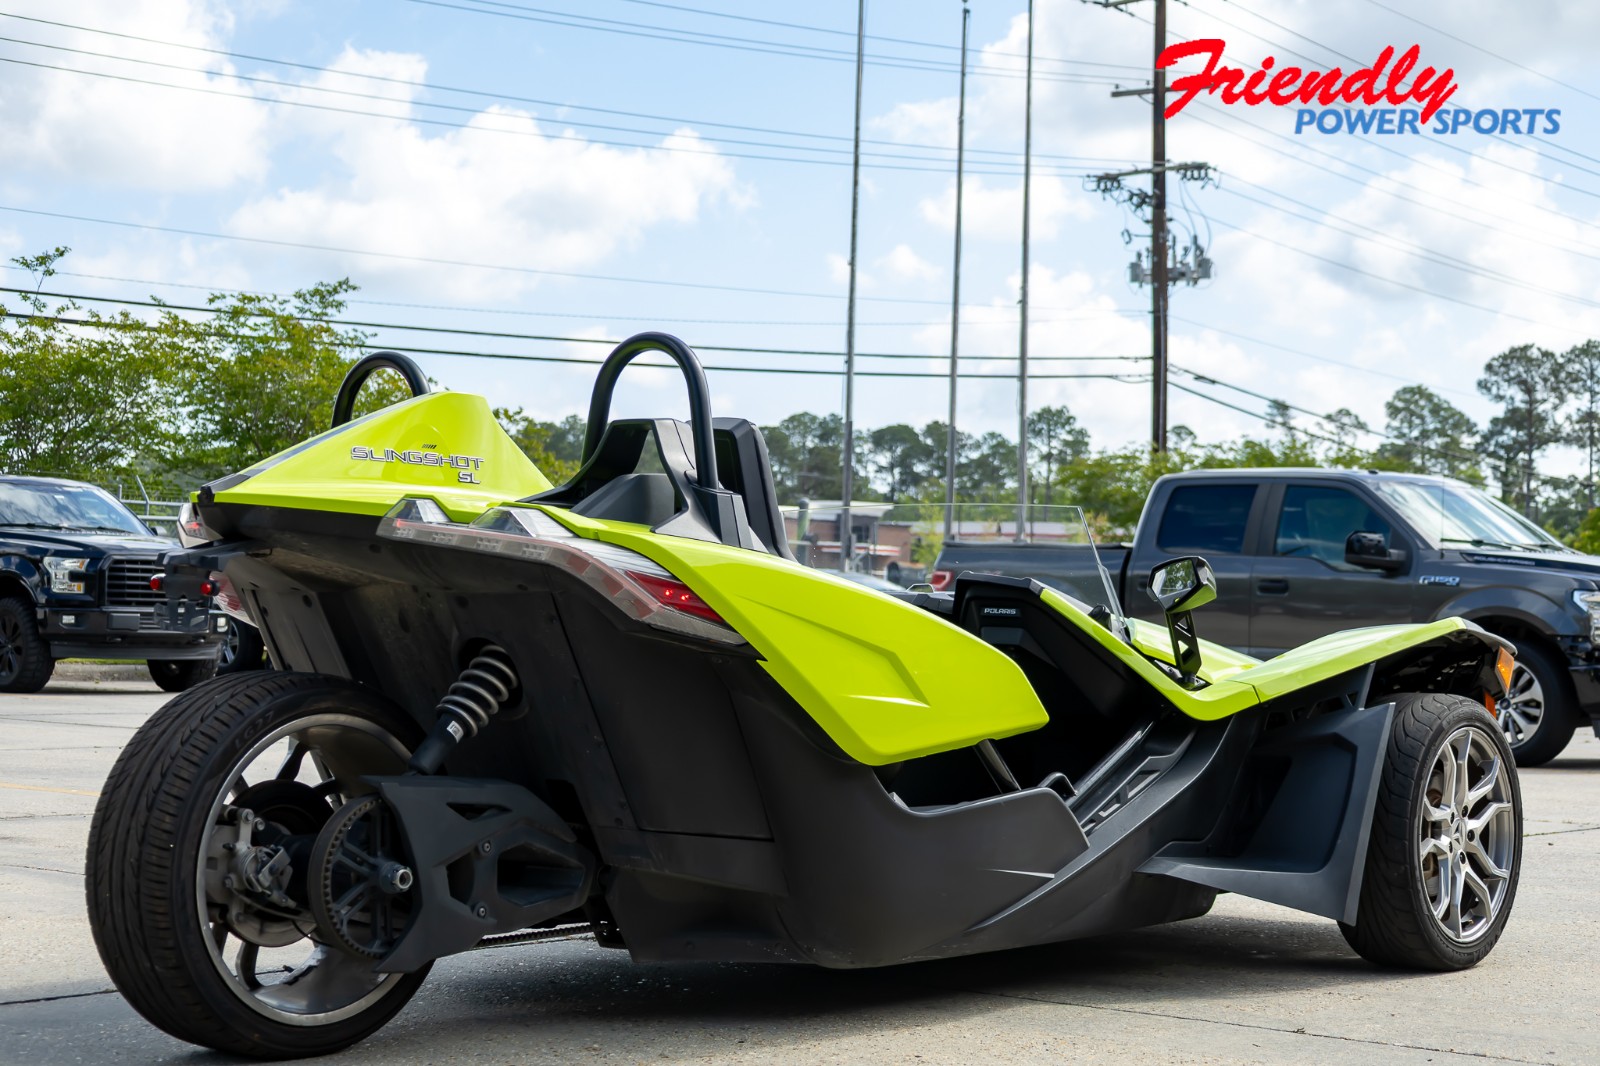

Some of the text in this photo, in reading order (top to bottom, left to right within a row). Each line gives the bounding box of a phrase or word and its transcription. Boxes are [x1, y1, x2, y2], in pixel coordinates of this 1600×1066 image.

[350, 446, 485, 471] SLINGSHOT
[457, 470, 481, 484] SL
[984, 607, 1016, 615] POLARIS
